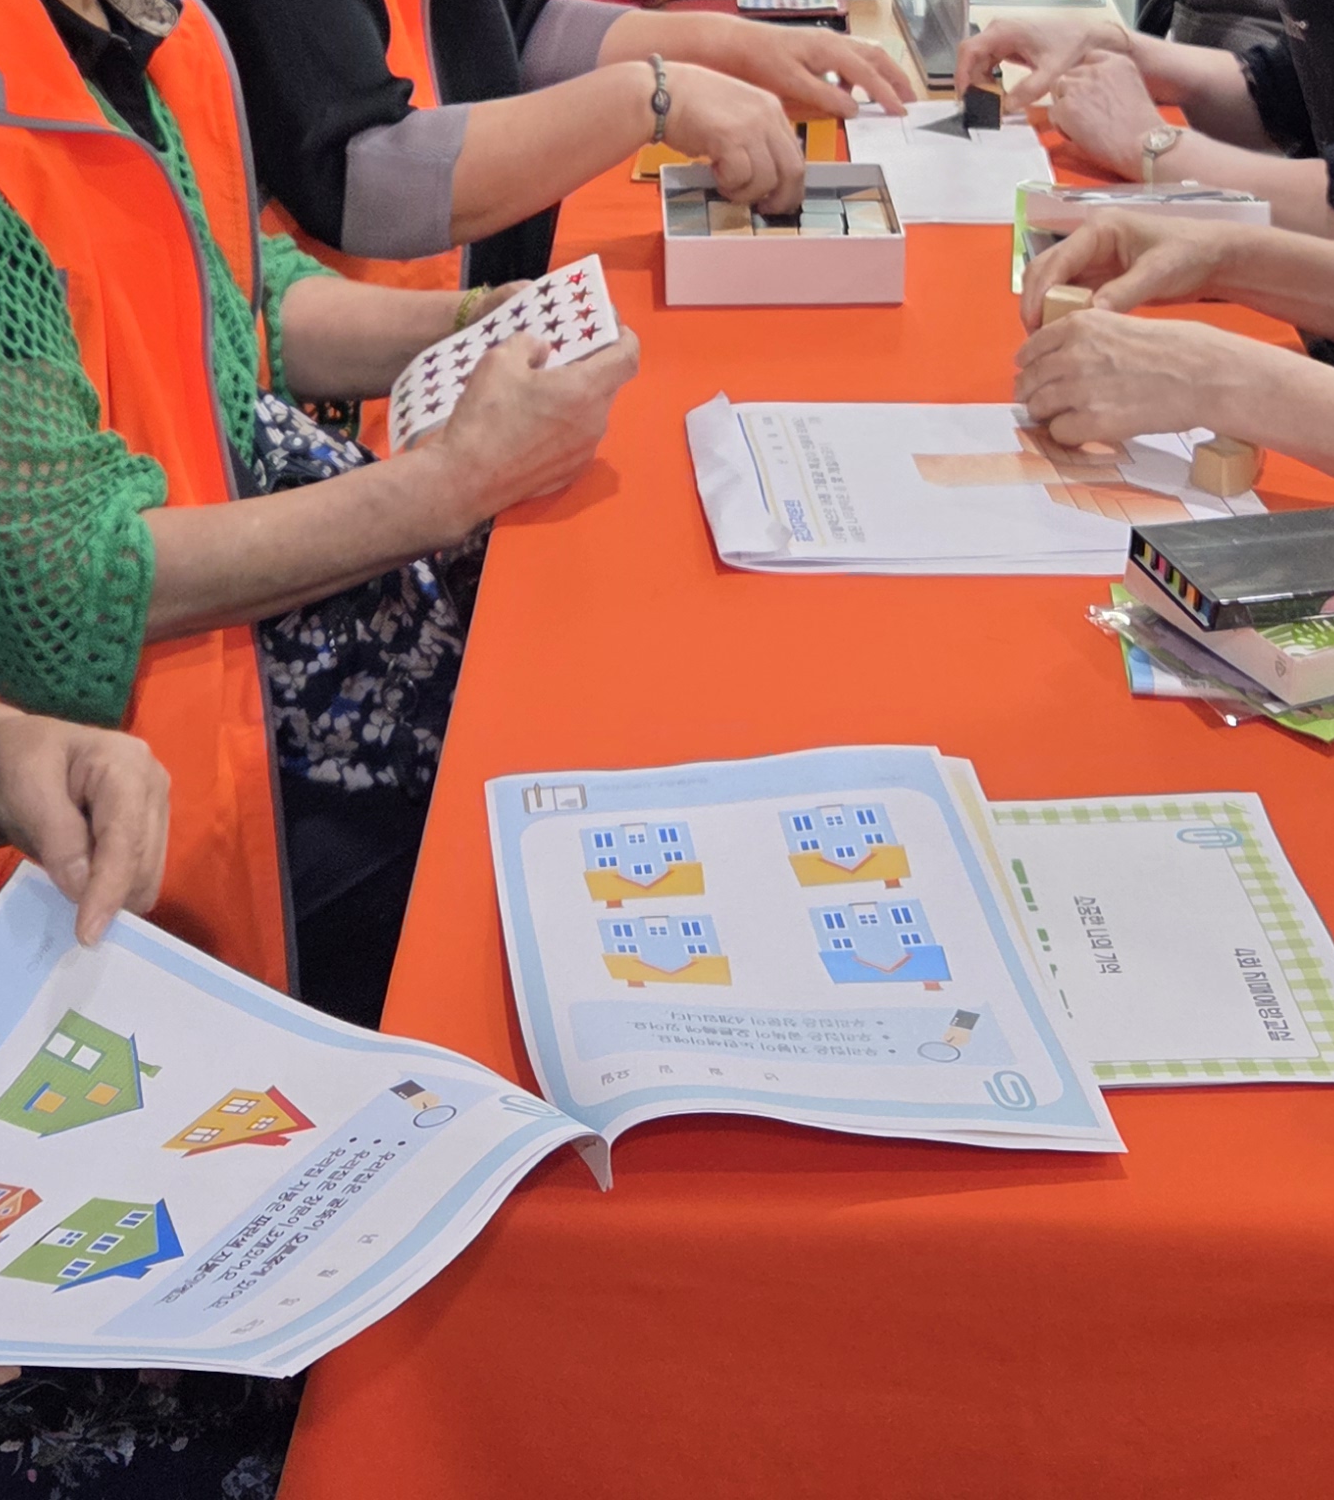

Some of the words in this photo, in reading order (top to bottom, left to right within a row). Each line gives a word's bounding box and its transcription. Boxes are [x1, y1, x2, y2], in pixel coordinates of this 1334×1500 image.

[1074, 896, 1105, 925] 소중한
[1086, 928, 1114, 949] 나의
[1094, 953, 1122, 974] 기억
[1235, 948, 1262, 968] 4회
[1242, 972, 1295, 1041] 치매예방교실
[304, 1147, 346, 1177] 우리집
[316, 1149, 370, 1192] 우리집은
[341, 1151, 396, 1194] 우리집은
[265, 1179, 310, 1213] 지붕은
[278, 1194, 323, 1227] 창문이
[303, 1197, 349, 1231] 굴뚝이
[224, 1214, 273, 1250] 파란색
[250, 1232, 309, 1278] 오른쪽에
